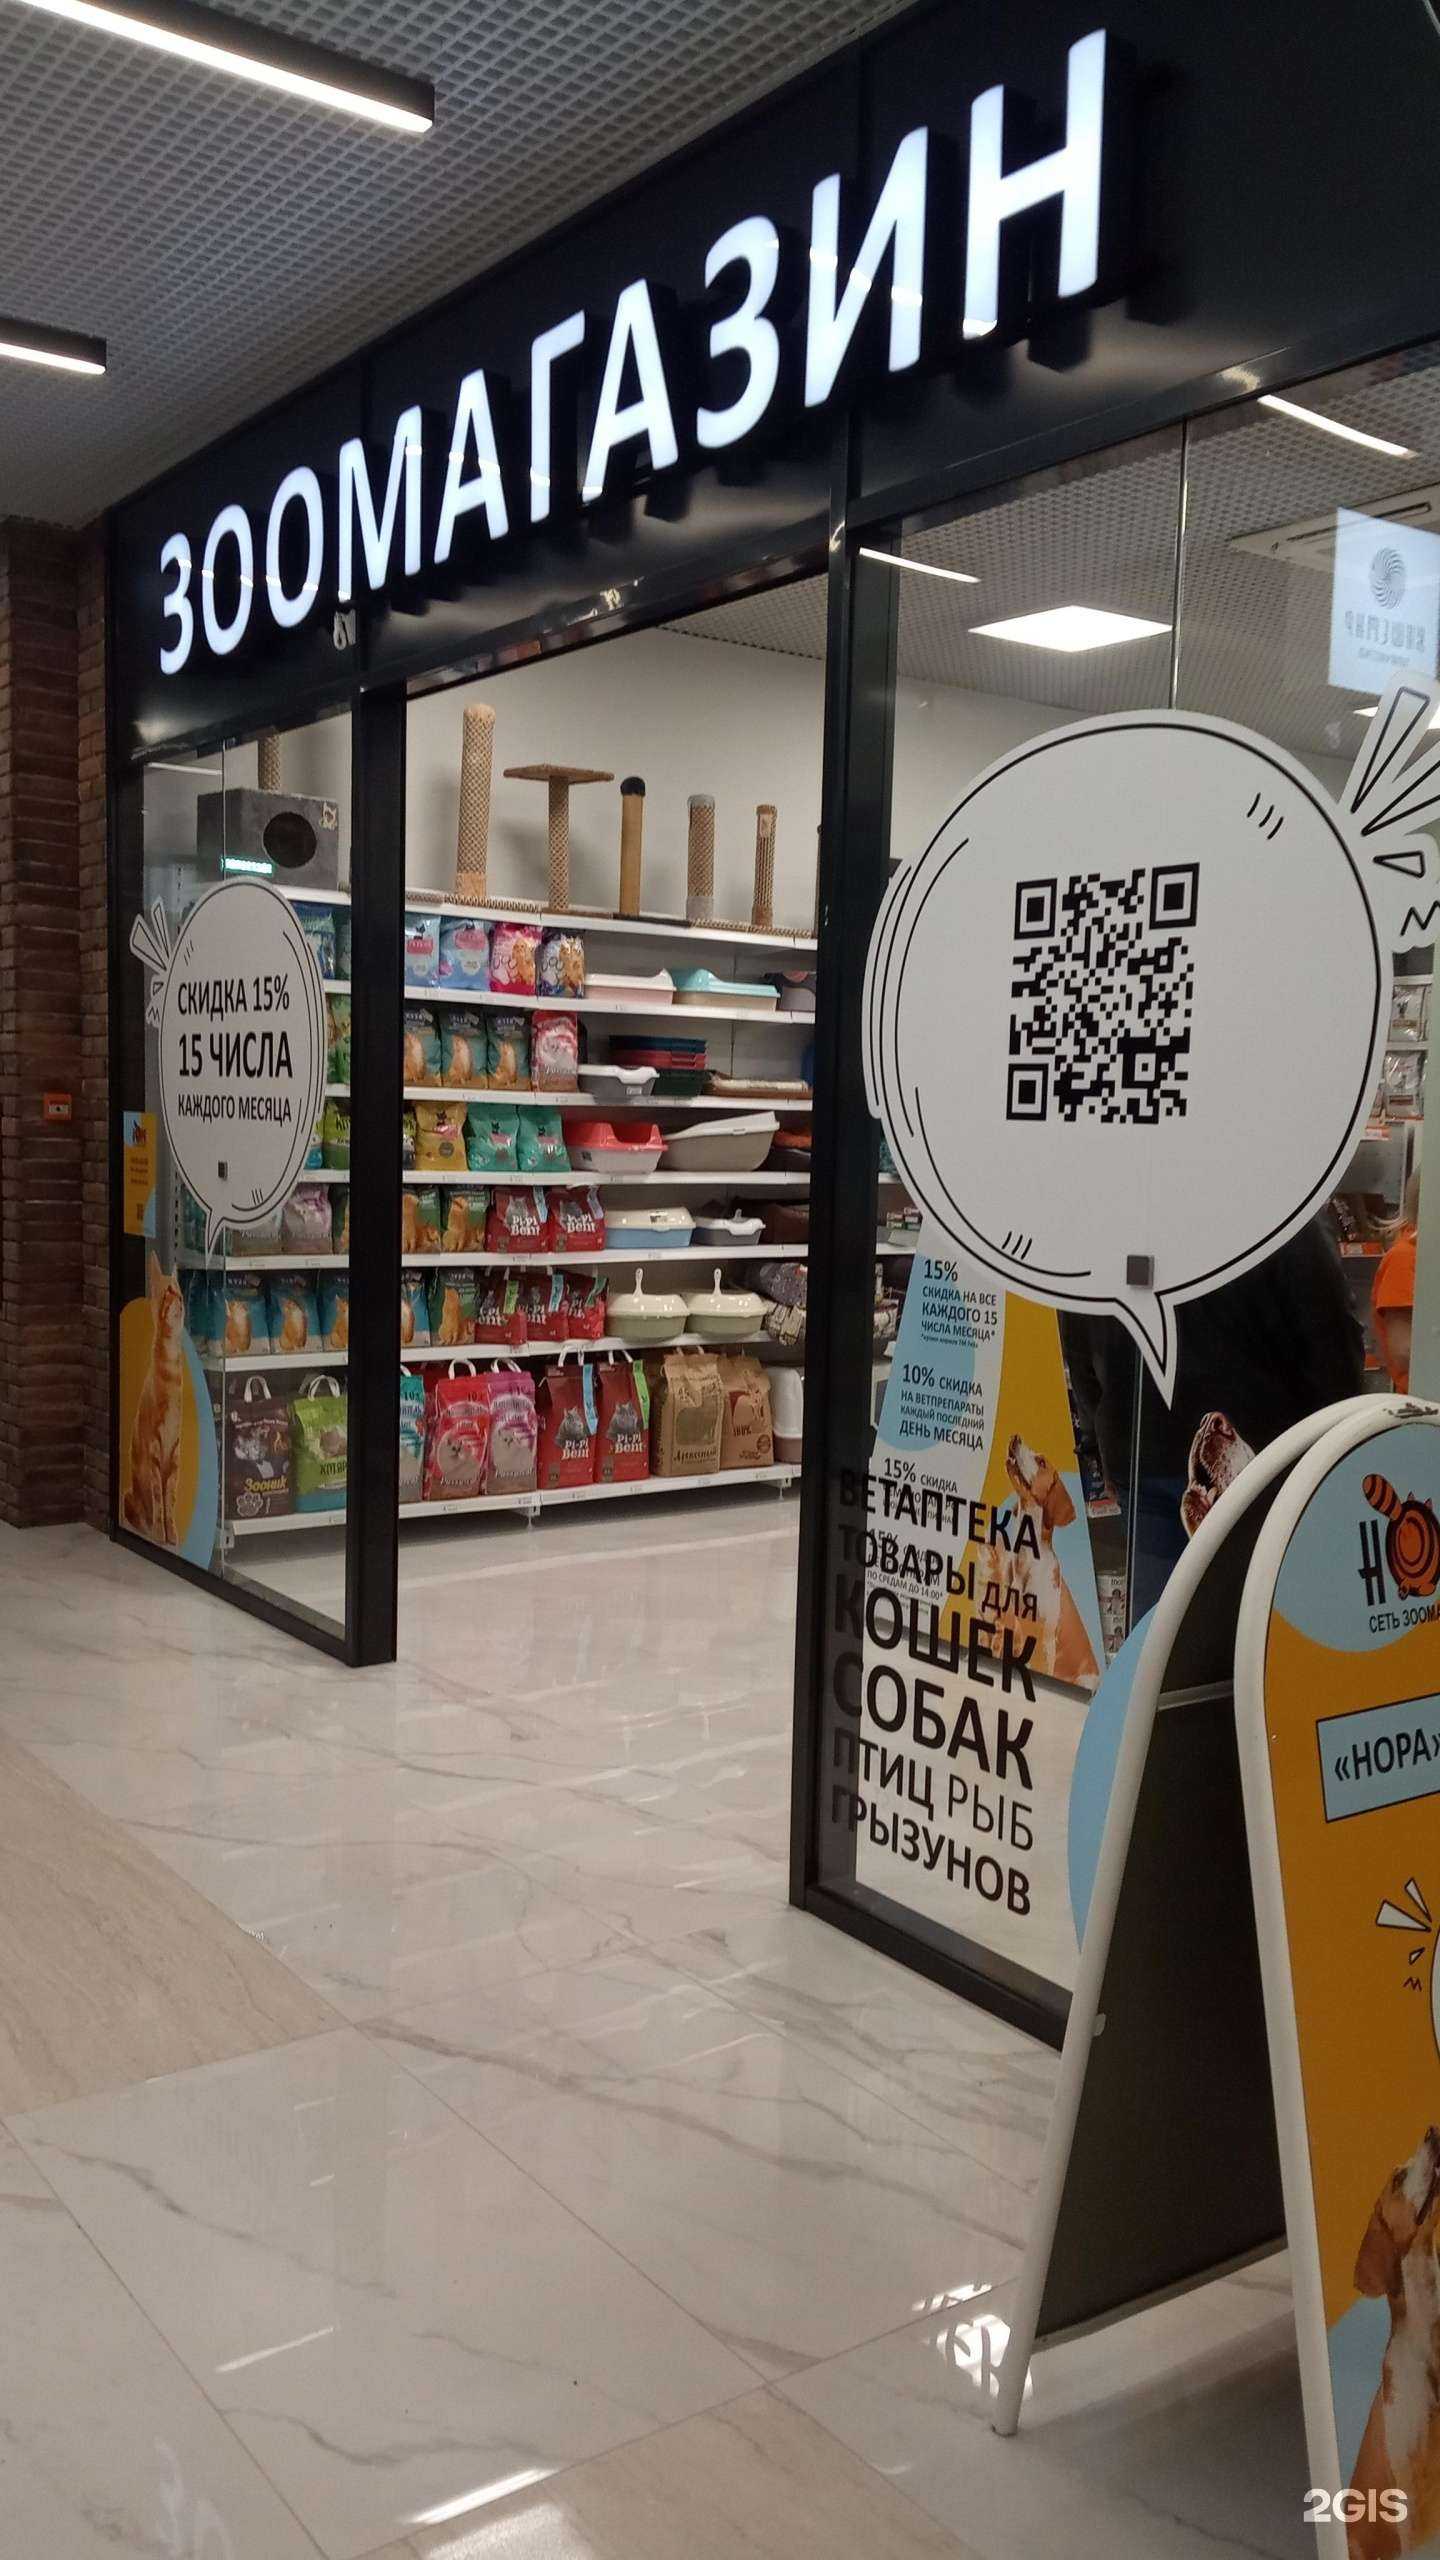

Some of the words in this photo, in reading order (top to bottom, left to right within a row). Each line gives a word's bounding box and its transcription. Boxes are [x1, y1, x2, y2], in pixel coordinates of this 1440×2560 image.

[159, 29, 1107, 676] ЗООМАГАЗИН
[178, 978, 247, 1022] СКИДКА
[253, 973, 289, 1011] 15%
[179, 1033, 203, 1077] 15
[210, 1031, 293, 1078] ЧИСЛА
[178, 1093, 235, 1123] КАЖДОГО
[239, 1096, 291, 1127] МЕСЯЦА
[924, 1259, 958, 1282] 15%
[922, 1286, 960, 1302] СКИДКА
[963, 1290, 977, 1303] НА
[979, 1293, 997, 1306] ВСЕ
[921, 1321, 951, 1334] ЧИСЛА
[922, 1302, 980, 1322] КАЖДОГО
[984, 1310, 998, 1325] 15
[903, 1363, 935, 1387] 10%
[939, 1376, 983, 1397] СКИДКА
[900, 1404, 935, 1420] КАЖДЫЙ
[936, 1411, 985, 1430] ПОСЛЕДНИЙ
[901, 1389, 913, 1402] НА
[915, 1392, 984, 1416] ВЕТПРЕПАРАТЫ
[614, 1441, 643, 1454] Bent
[900, 1420, 931, 1438] ДЕНЬ
[933, 1426, 983, 1450] МЕСЯЦА
[561, 1448, 589, 1460] Bent
[884, 1457, 916, 1482] 15%
[920, 1473, 958, 1493] СКИДКА
[839, 1467, 1041, 1560] ВЕТАПТЕКА
[838, 1523, 975, 1600] ТОВАРЫ
[981, 1584, 1038, 1622] ДЛЯ
[908, 1583, 919, 1593] ДО
[834, 1573, 1037, 1702] КОШЕК
[1369, 1613, 1400, 1634] СЕТЬ
[833, 1650, 1034, 1790] СОБАК
[833, 1727, 935, 1821] ПТИЦ
[947, 1774, 1033, 1852] РЫБ
[832, 1784, 1031, 1917] ГРЫЗУНОВ
